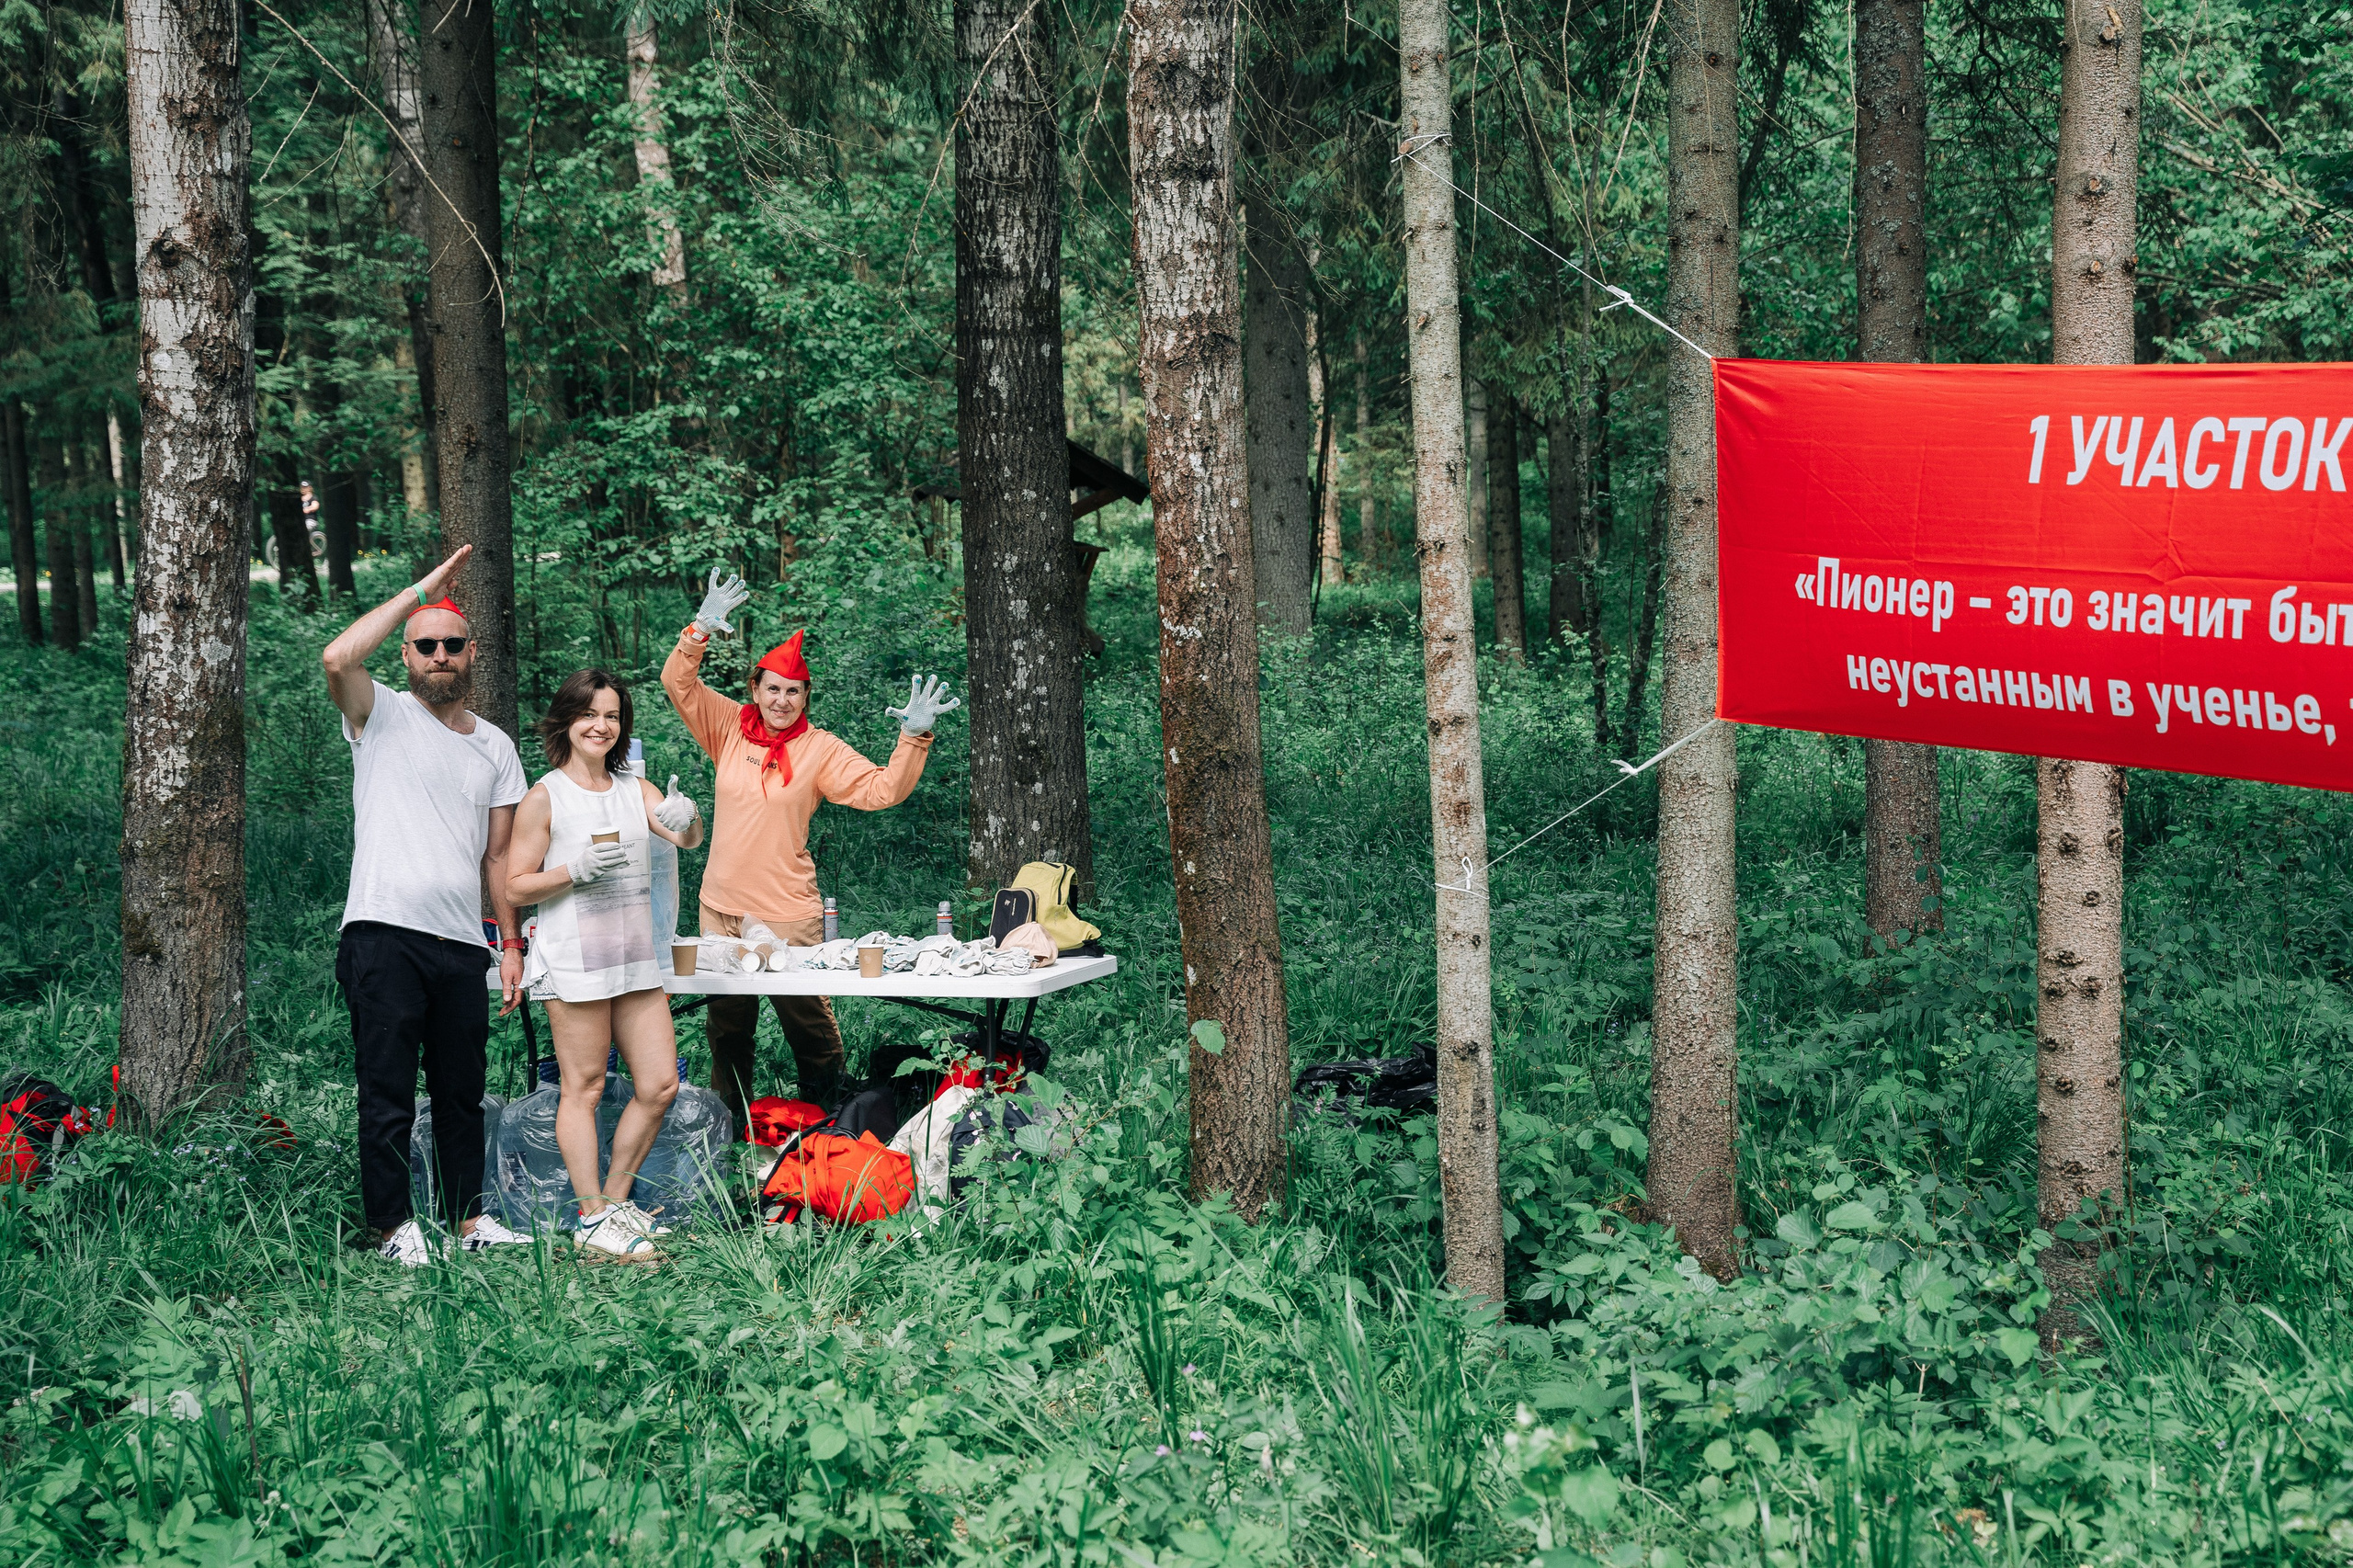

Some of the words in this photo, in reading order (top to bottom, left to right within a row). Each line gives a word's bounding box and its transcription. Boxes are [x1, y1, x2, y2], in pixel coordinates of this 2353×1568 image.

[2028, 415, 2051, 484] 1
[2065, 415, 2353, 493] УЧАСТОК
[1794, 556, 1955, 632] «Пионер
[2006, 585, 2074, 628] это
[2086, 590, 2252, 640] значит
[1847, 654, 2094, 713] неустанным
[2108, 678, 2134, 717] в
[2145, 682, 2336, 746] ученье,
